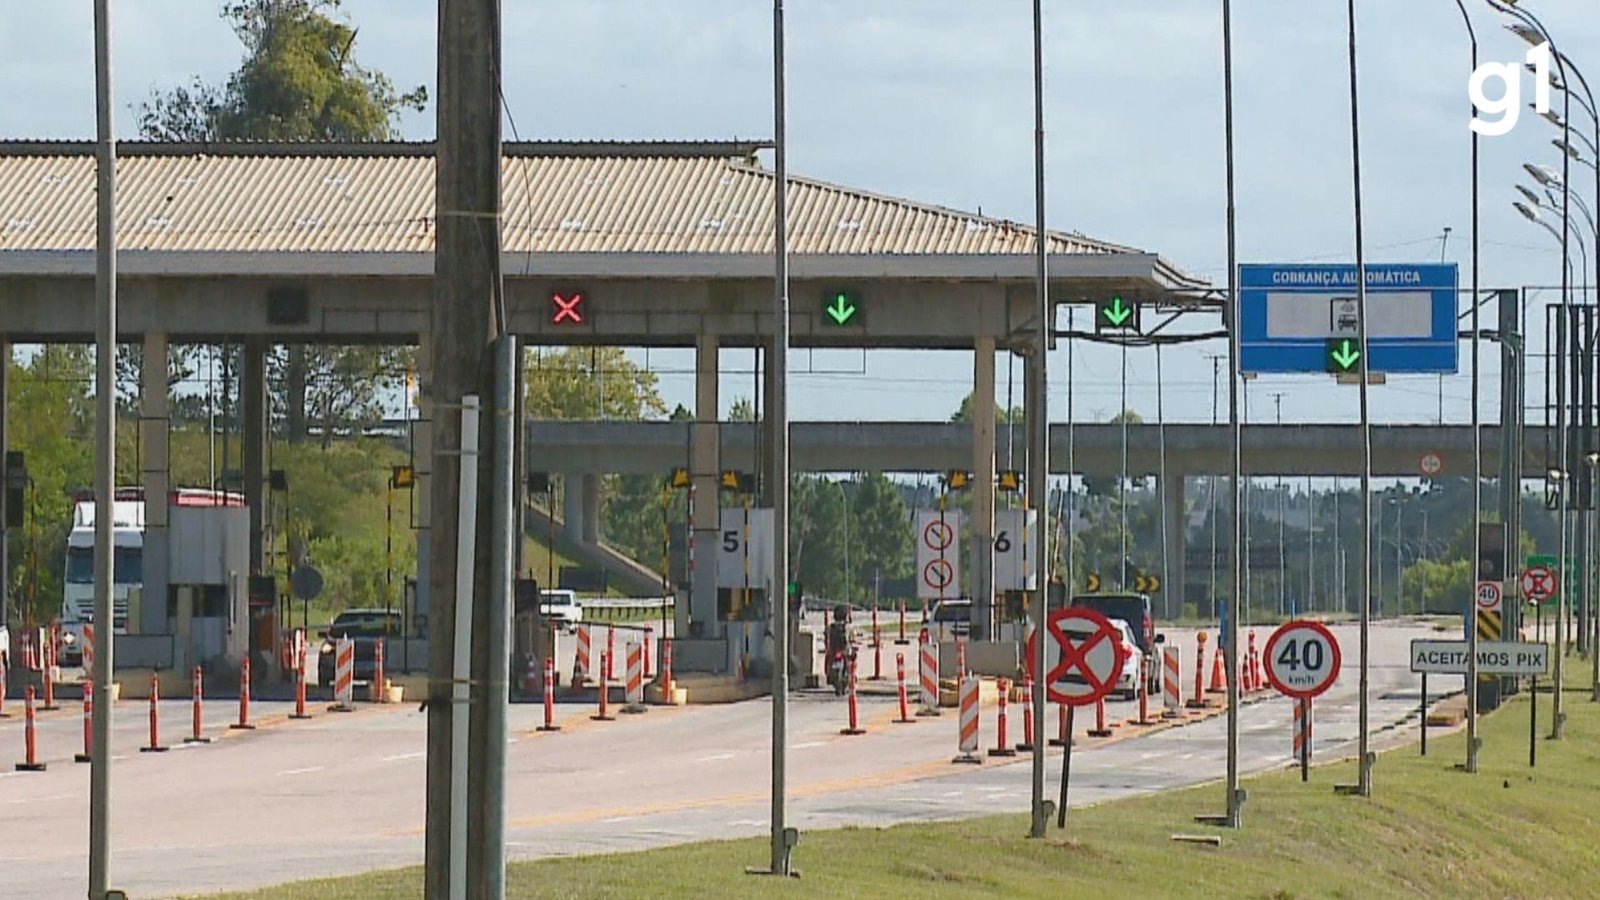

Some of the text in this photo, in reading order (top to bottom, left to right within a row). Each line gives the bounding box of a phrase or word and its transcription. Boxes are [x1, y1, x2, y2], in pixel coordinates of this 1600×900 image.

[1272, 269, 1421, 286] COBRANÇA AUOMÁTICA
[722, 530, 739, 553] 5
[994, 530, 1011, 553] 6
[1479, 588, 1495, 600] 40
[1277, 638, 1323, 671] 40
[1516, 652, 1542, 667] PIX
